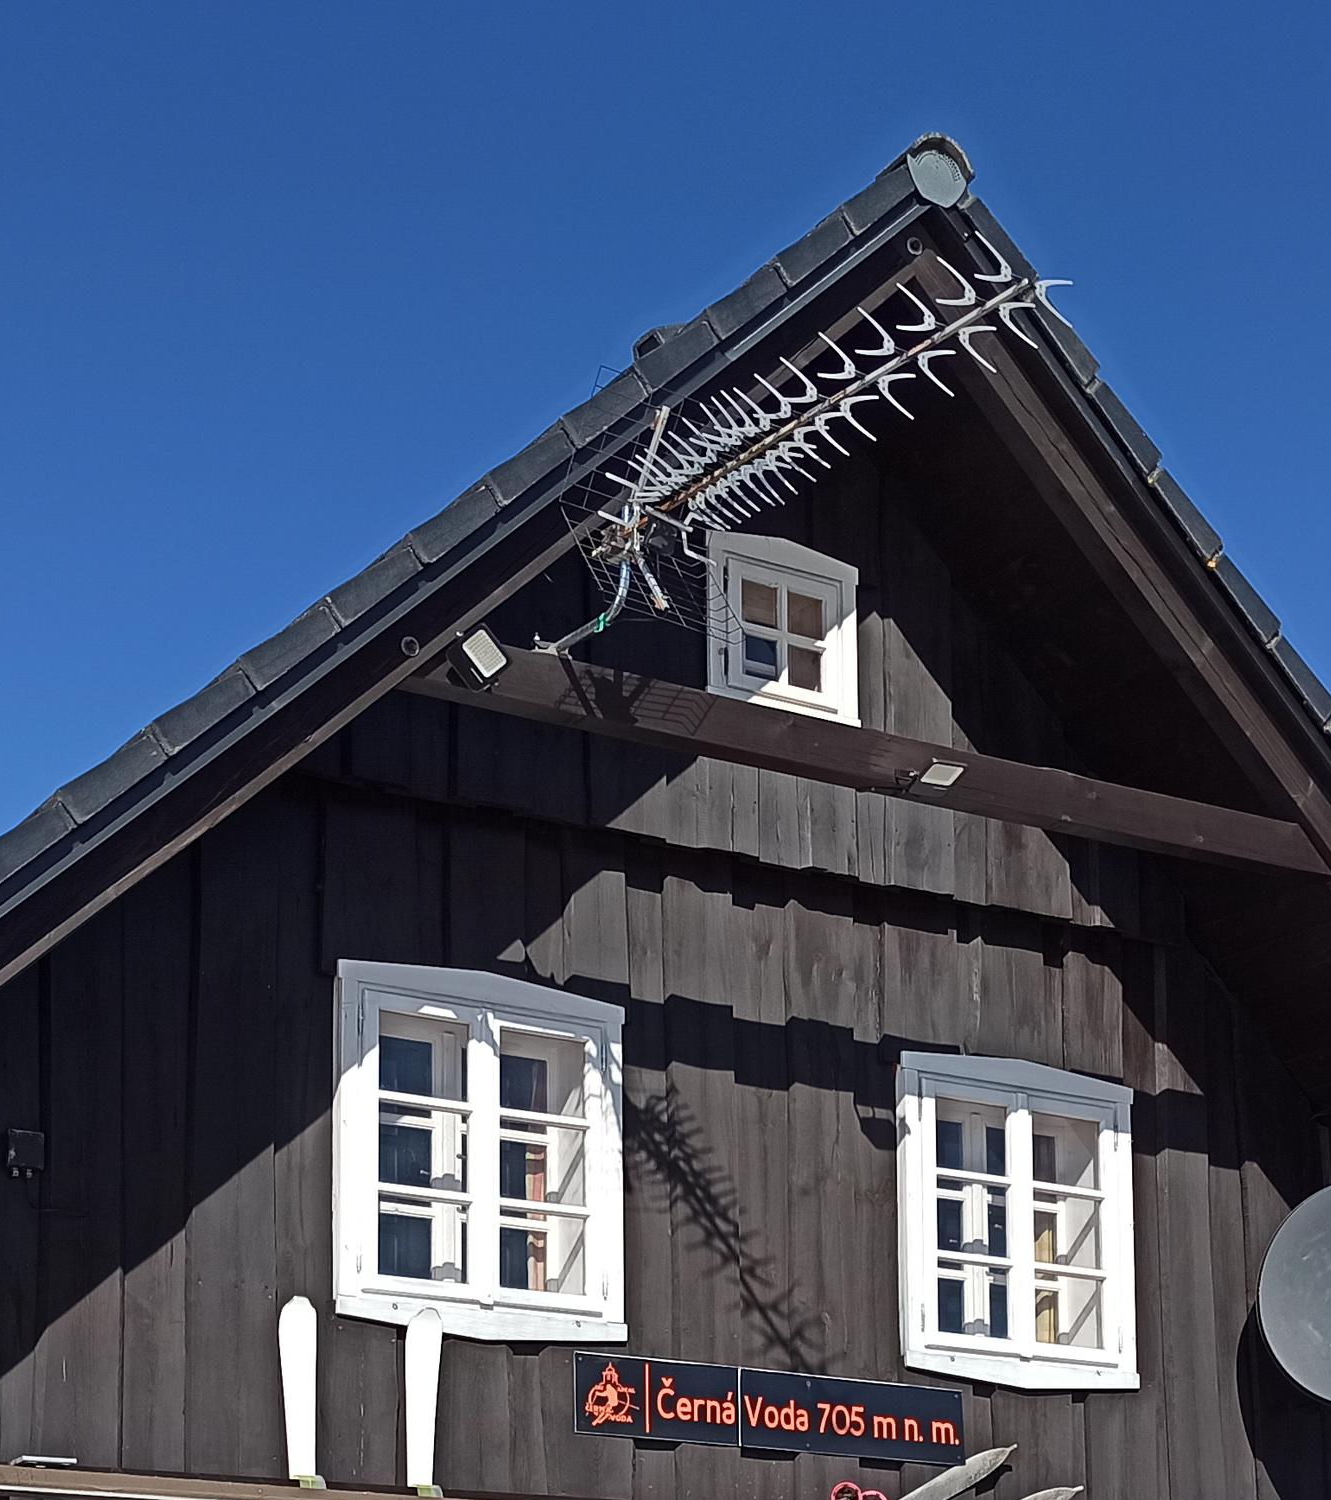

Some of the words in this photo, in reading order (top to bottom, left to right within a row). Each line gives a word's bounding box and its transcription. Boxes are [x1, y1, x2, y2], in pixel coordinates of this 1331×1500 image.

[656, 1376, 737, 1426] Černá
[744, 1394, 809, 1432] Voda
[817, 1402, 866, 1437] 705
[873, 1414, 897, 1441] m
[904, 1417, 925, 1443] n.
[932, 1420, 960, 1446] m.
